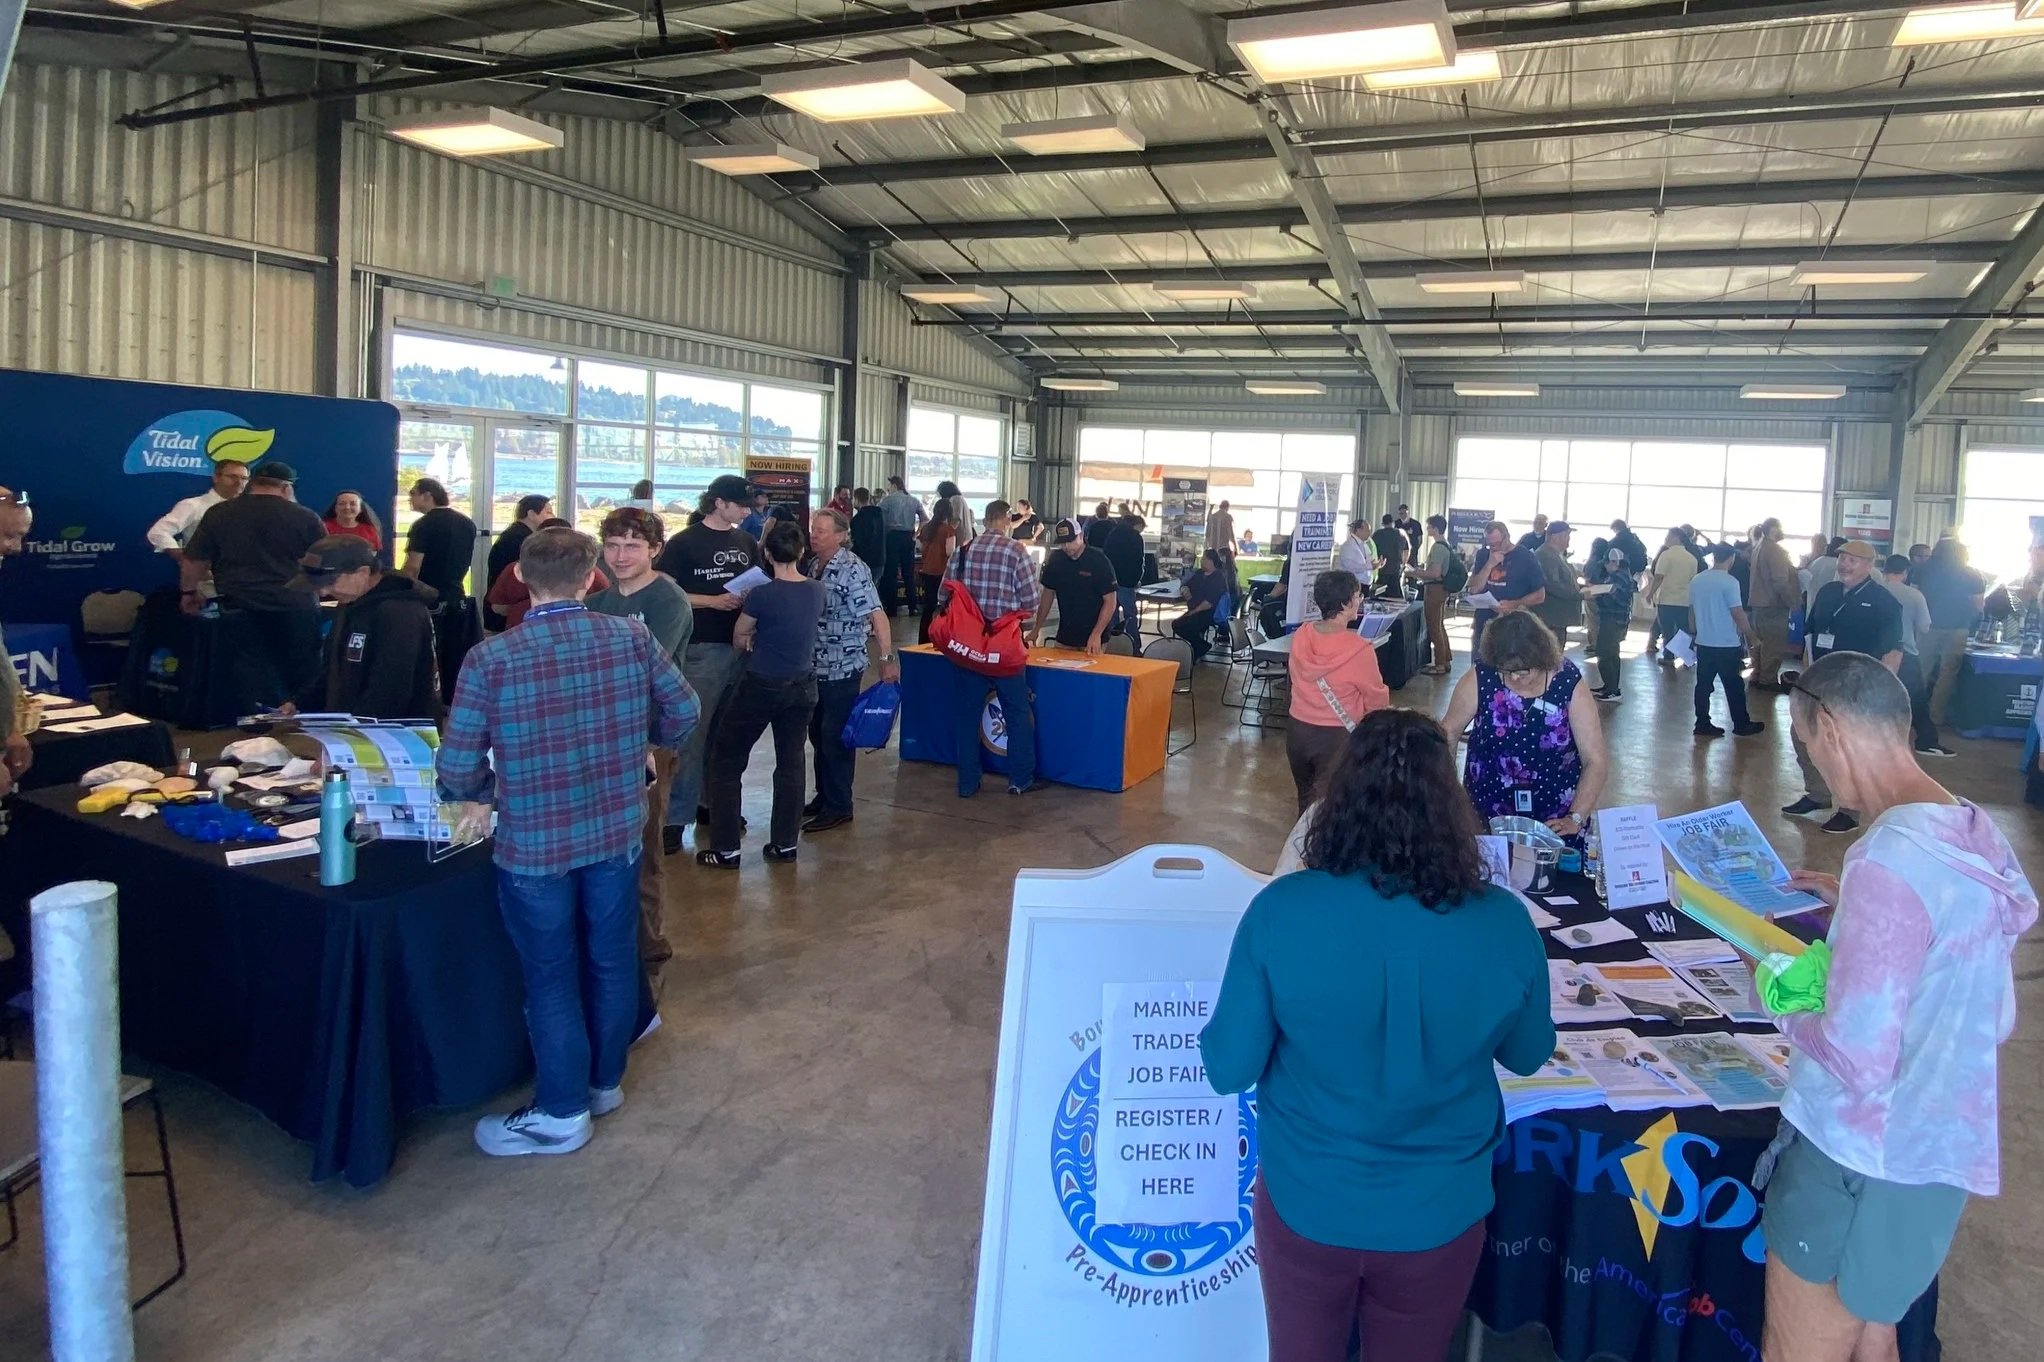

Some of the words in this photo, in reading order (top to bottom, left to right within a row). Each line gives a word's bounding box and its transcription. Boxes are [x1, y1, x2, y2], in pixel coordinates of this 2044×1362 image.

[149, 429, 199, 450] Tidal
[142, 450, 202, 468] Vision
[750, 461, 773, 470] NOW
[775, 462, 808, 471] HIRING
[1301, 513, 1317, 523] NEED
[1469, 525, 1486, 534] Hirin
[27, 540, 68, 553] Tidal
[71, 541, 116, 553] Grow
[1297, 541, 1312, 551] NEW
[1708, 809, 1734, 820] Worker
[1681, 823, 1703, 837] JOB
[1702, 817, 1729, 832] FAIR
[1134, 1000, 1208, 1018] MARINE
[1127, 1066, 1164, 1084] JOB
[1115, 1108, 1210, 1128] REGISTER
[1214, 1108, 1223, 1126] /
[1120, 1143, 1191, 1161] CHECK
[1196, 1142, 1216, 1160] IN
[1141, 1177, 1195, 1196] HERE
[1065, 1242, 1260, 1308] Pre-Apprenticeship
